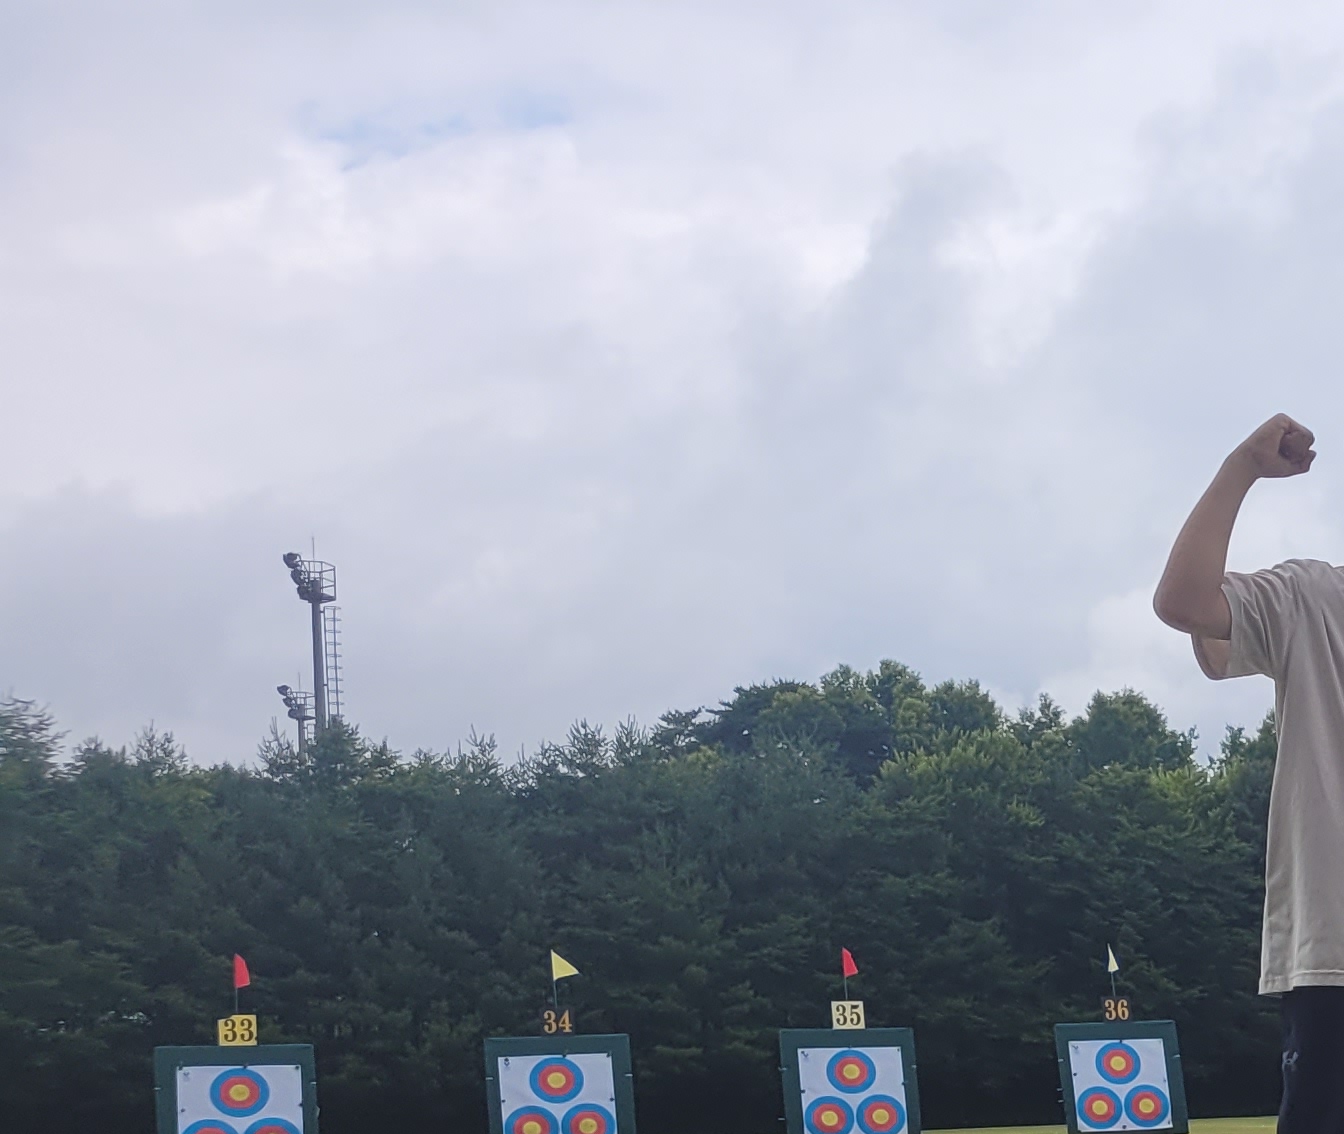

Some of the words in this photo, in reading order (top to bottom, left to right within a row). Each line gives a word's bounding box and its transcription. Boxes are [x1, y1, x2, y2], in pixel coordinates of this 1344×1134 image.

[543, 1008, 572, 1034] 34
[835, 1003, 862, 1028] 35
[1104, 997, 1129, 1022] 36
[222, 1018, 256, 1043] 33
